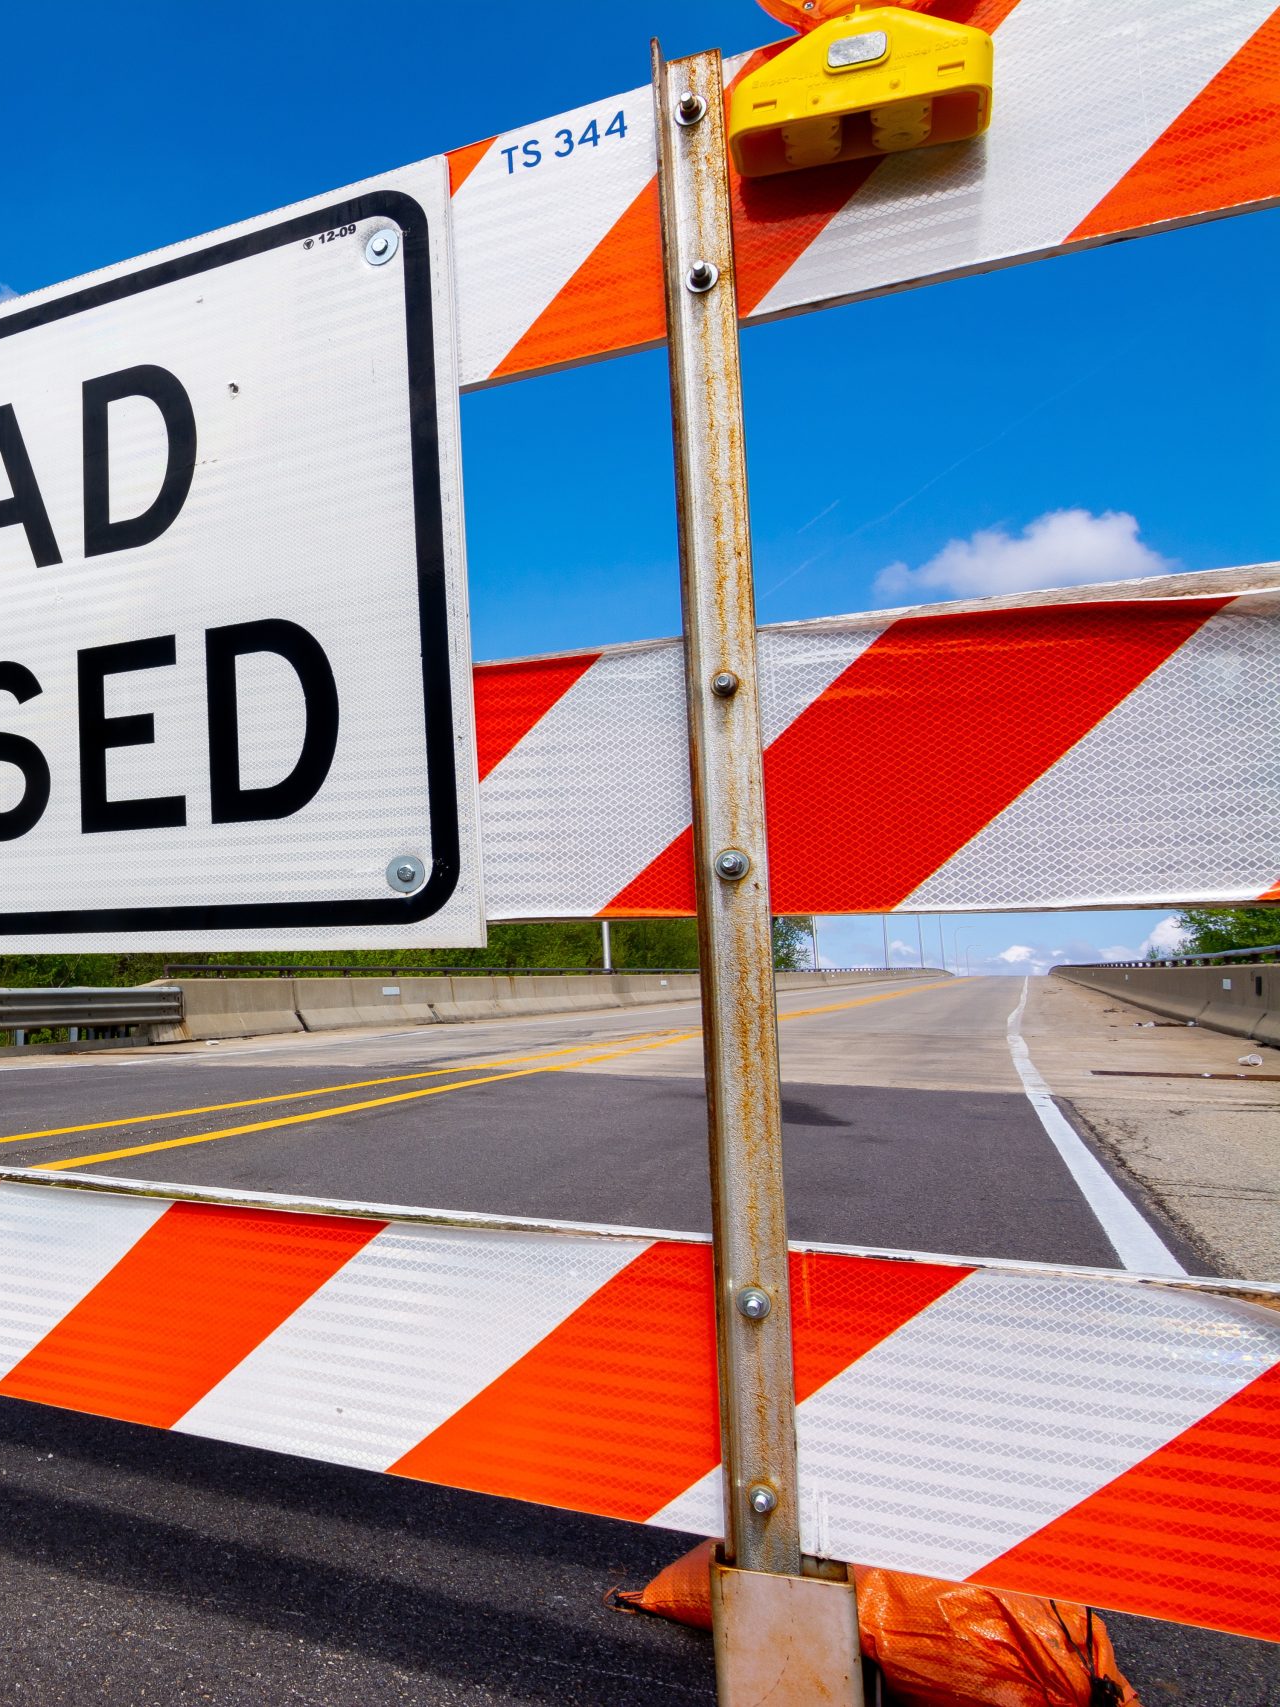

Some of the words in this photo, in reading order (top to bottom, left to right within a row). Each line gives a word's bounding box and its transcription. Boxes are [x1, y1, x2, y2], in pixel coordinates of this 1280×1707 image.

[501, 139, 542, 175] TS
[554, 110, 628, 158] 344
[318, 223, 357, 245] 12-09
